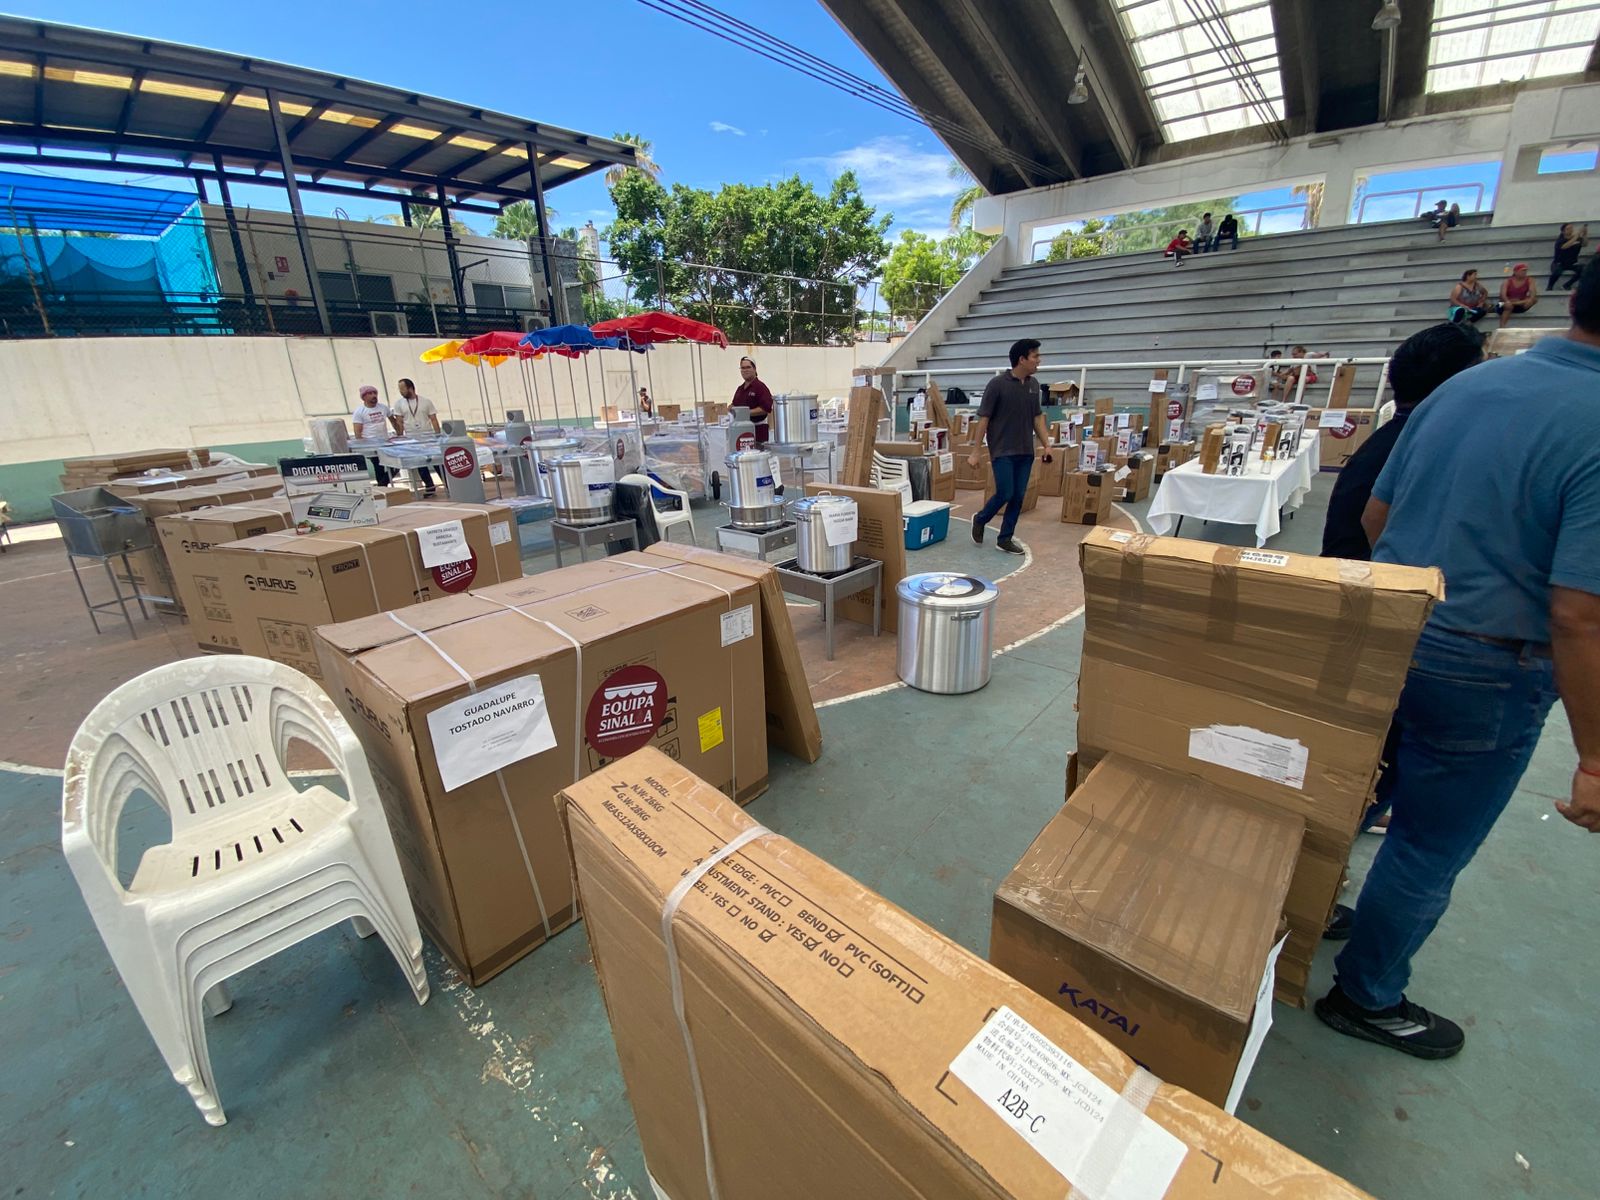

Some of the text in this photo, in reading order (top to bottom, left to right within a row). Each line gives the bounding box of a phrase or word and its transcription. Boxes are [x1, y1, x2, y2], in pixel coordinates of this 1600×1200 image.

[256, 576, 297, 591] AURUS
[449, 698, 535, 736] TOSTADO NAVARRO
[463, 692, 517, 717] GUADALUPE
[602, 695, 654, 717] EQUIPA
[644, 776, 671, 798] MODEL:
[711, 892, 730, 908] YES
[740, 915, 759, 931] NO
[760, 883, 782, 900] PVC
[797, 909, 829, 933] BEND
[844, 942, 871, 964] PVC
[868, 960, 911, 994] (SOFT)
[786, 923, 807, 942] YES
[819, 949, 840, 967] NO
[1058, 982, 1141, 1037] KATAI
[976, 1043, 1030, 1093] MADE IN CHINA
[997, 1088, 1046, 1133] A2B-C
